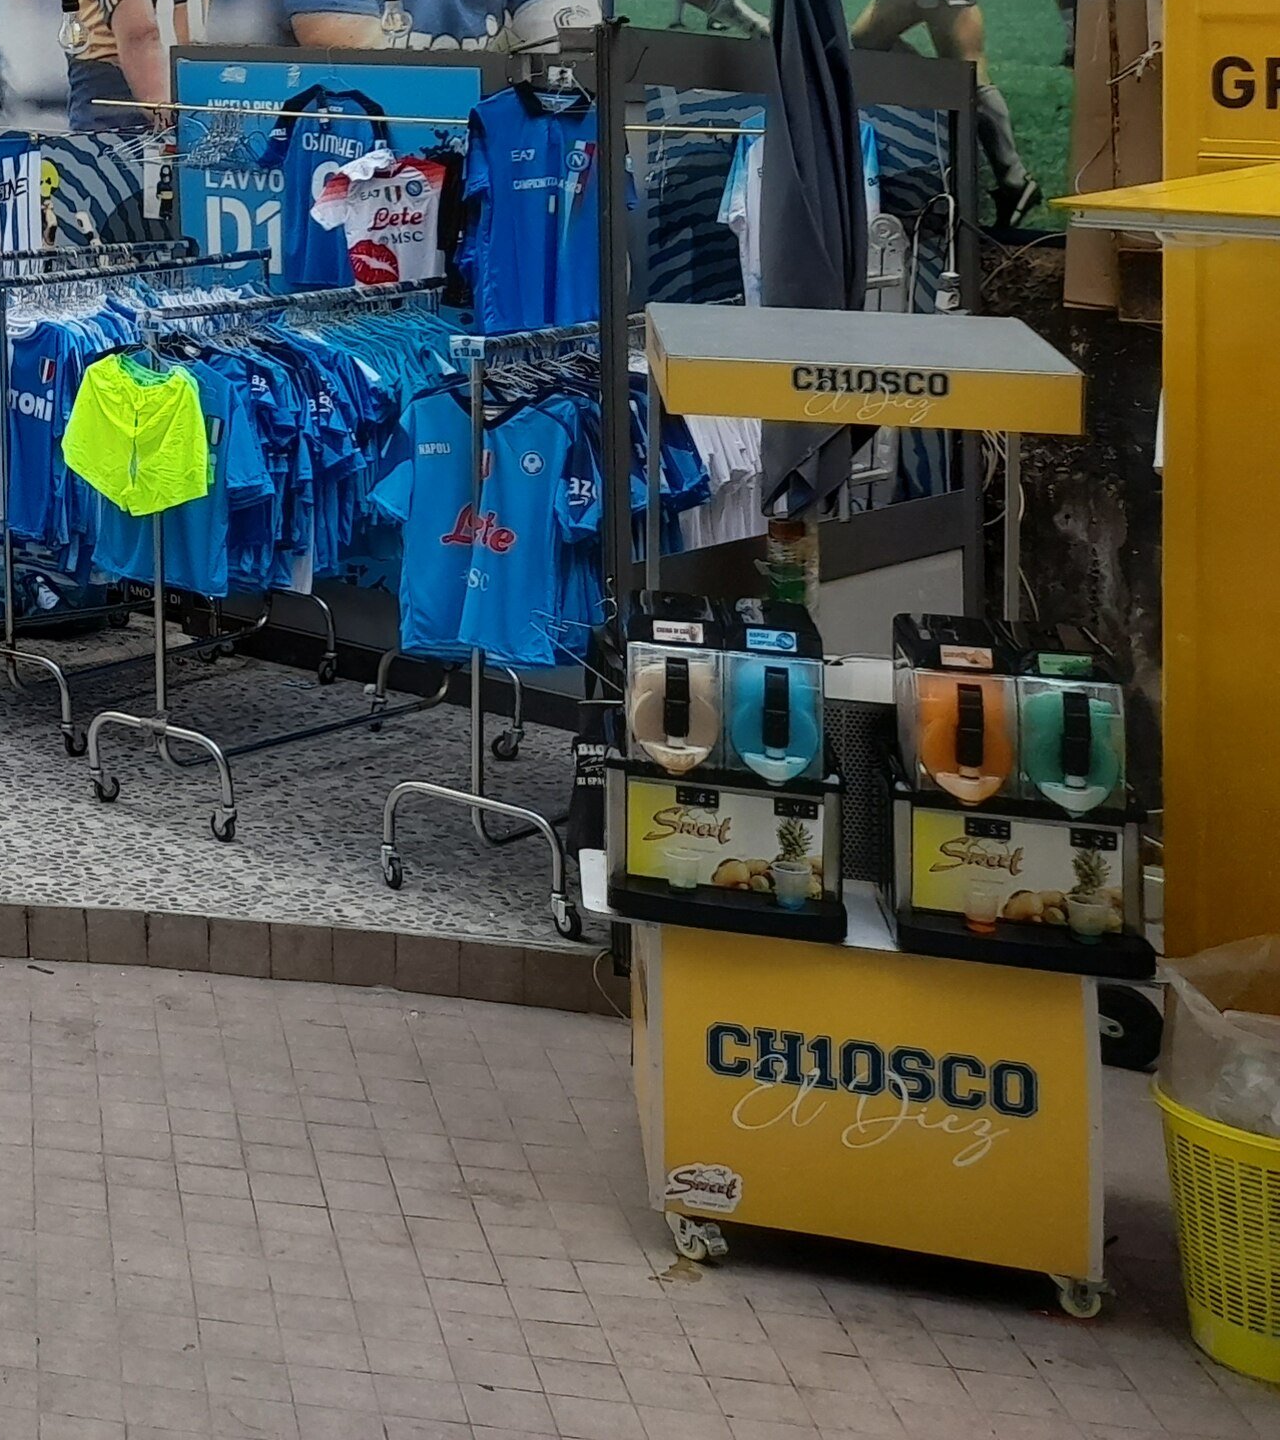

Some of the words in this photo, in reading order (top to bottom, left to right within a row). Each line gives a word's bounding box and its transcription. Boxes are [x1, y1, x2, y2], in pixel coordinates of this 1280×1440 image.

[511, 148, 536, 161] EA7
[360, 188, 381, 201] EA7
[367, 207, 423, 232] Lete
[390, 230, 424, 244] MSC
[417, 443, 451, 456] NAPOLI
[643, 807, 731, 844] Sweet
[929, 836, 1024, 876] Sweet
[731, 1053, 827, 1130] El
[841, 1069, 1010, 1168] Diez
[666, 1169, 737, 1200] Sweet
